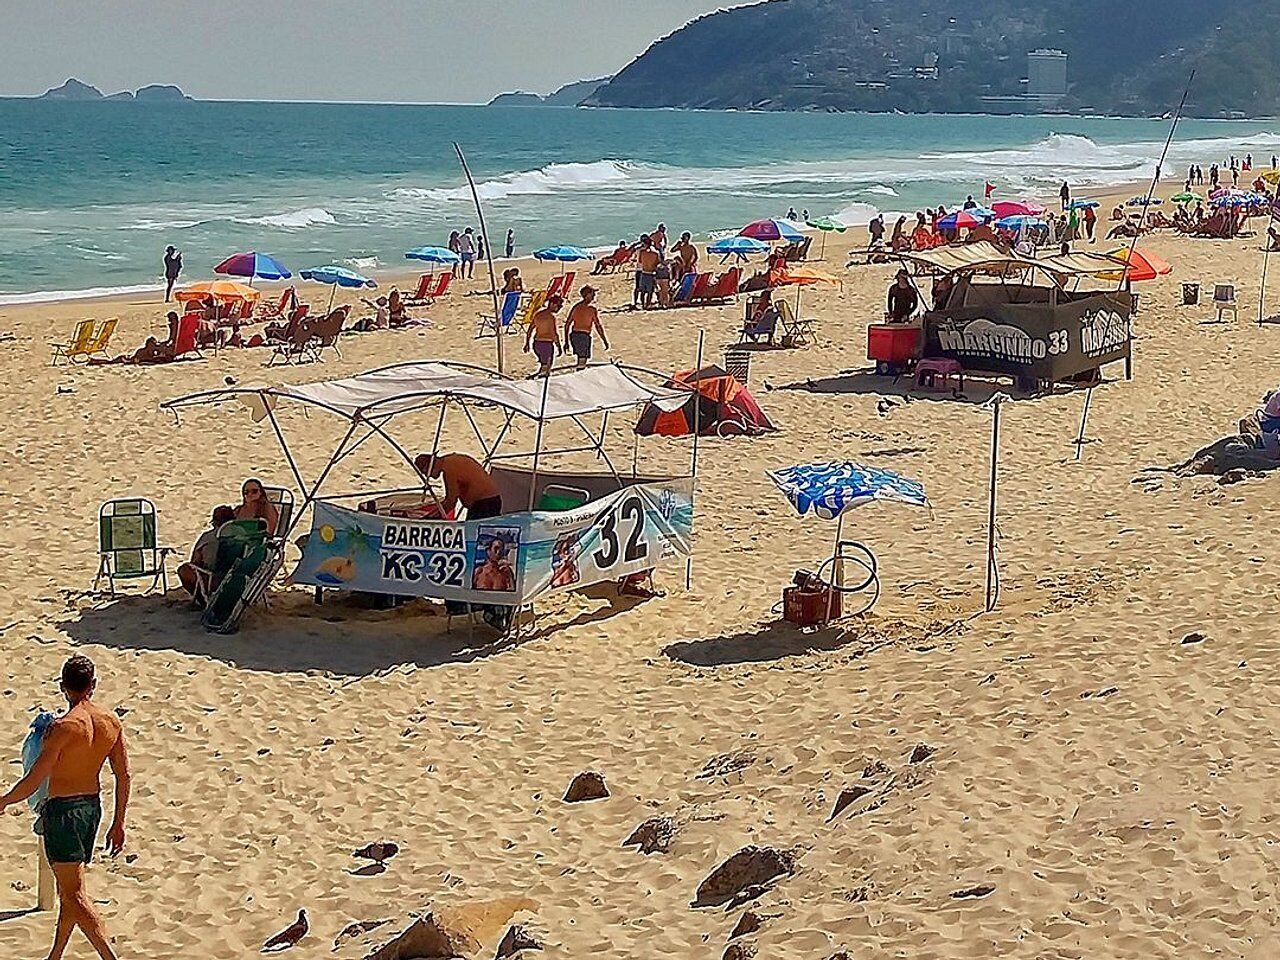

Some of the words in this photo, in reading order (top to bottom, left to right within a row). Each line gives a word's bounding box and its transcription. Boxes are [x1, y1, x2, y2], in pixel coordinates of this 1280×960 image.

[938, 331, 1046, 358] MARCINHO
[1048, 330, 1069, 354] 33
[384, 525, 464, 549] BARRACA
[592, 496, 648, 570] 32
